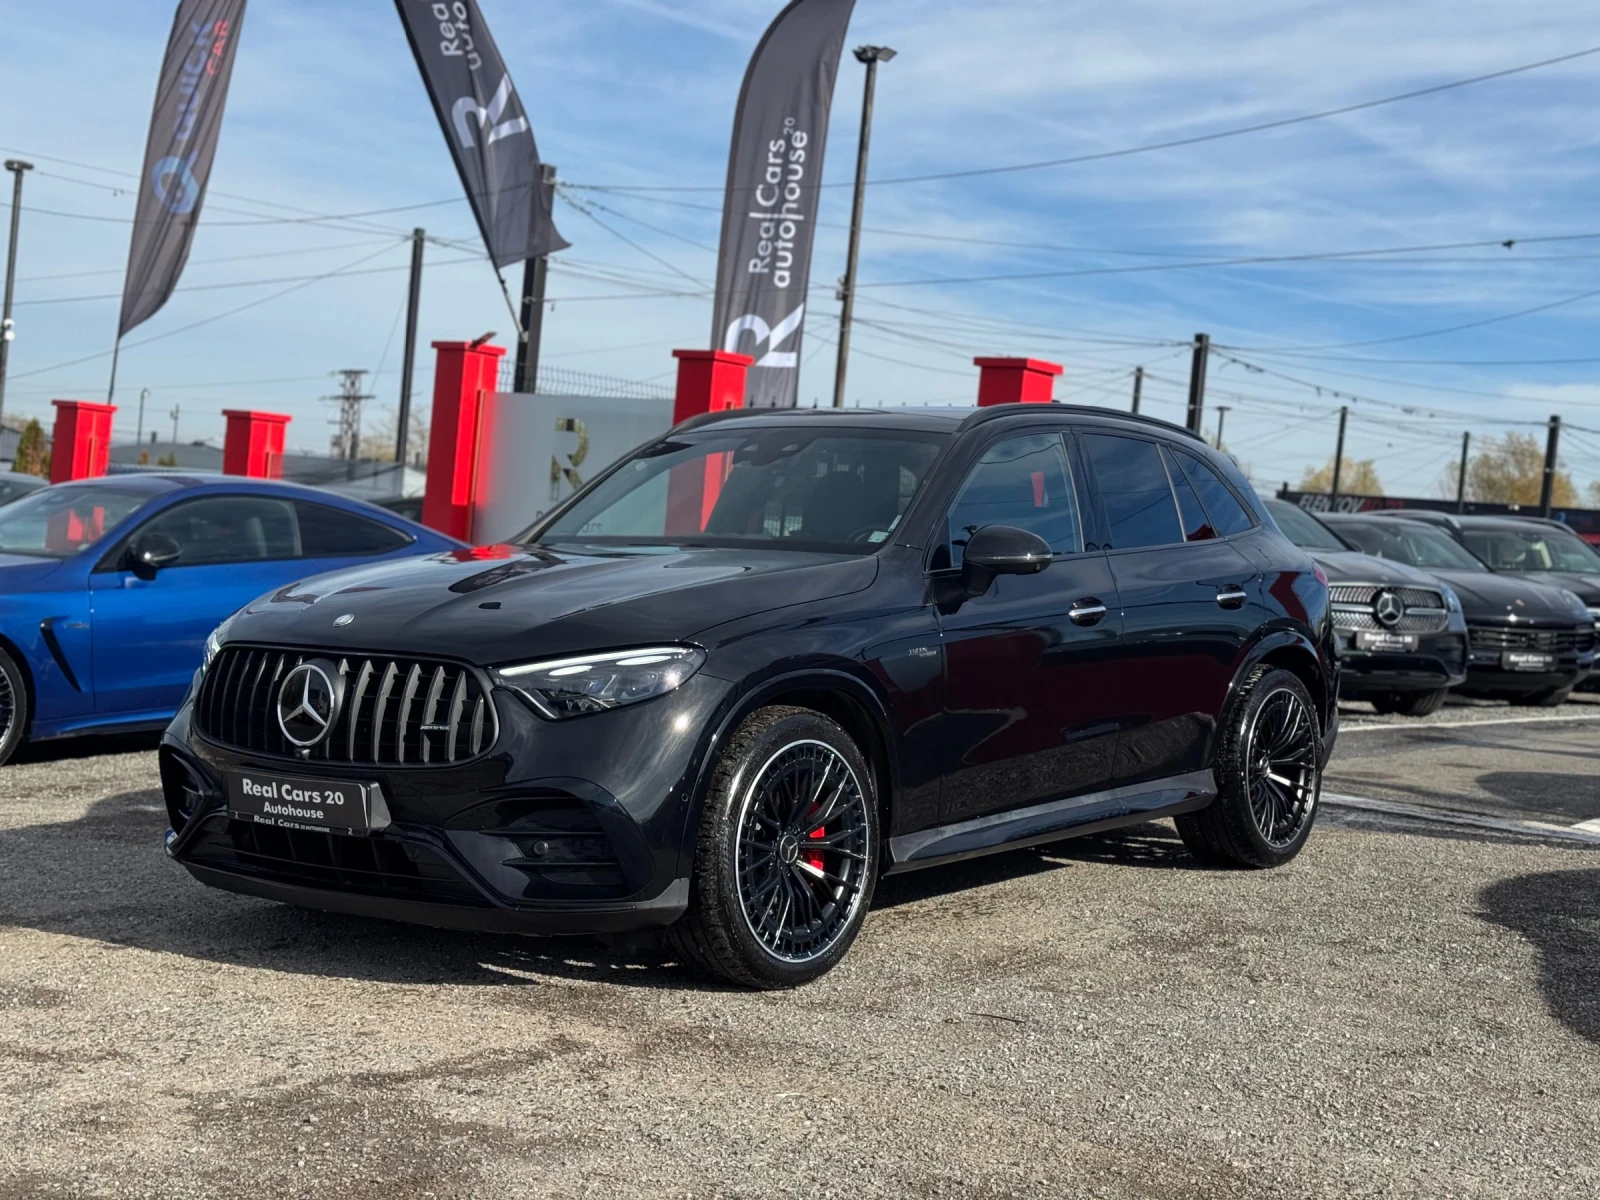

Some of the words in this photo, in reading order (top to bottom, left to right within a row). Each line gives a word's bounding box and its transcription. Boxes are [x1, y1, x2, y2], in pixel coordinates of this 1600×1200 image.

[206, 19, 229, 76] CAR
[783, 117, 796, 135] 20
[756, 139, 787, 207] Cars
[773, 130, 808, 288] autohouse
[748, 211, 776, 273] Real
[242, 778, 278, 798] Real
[281, 784, 322, 803] Cars
[324, 791, 345, 805] 20
[263, 802, 324, 819] Autohouse
[253, 814, 275, 825] Real
[278, 819, 300, 829] Cars
